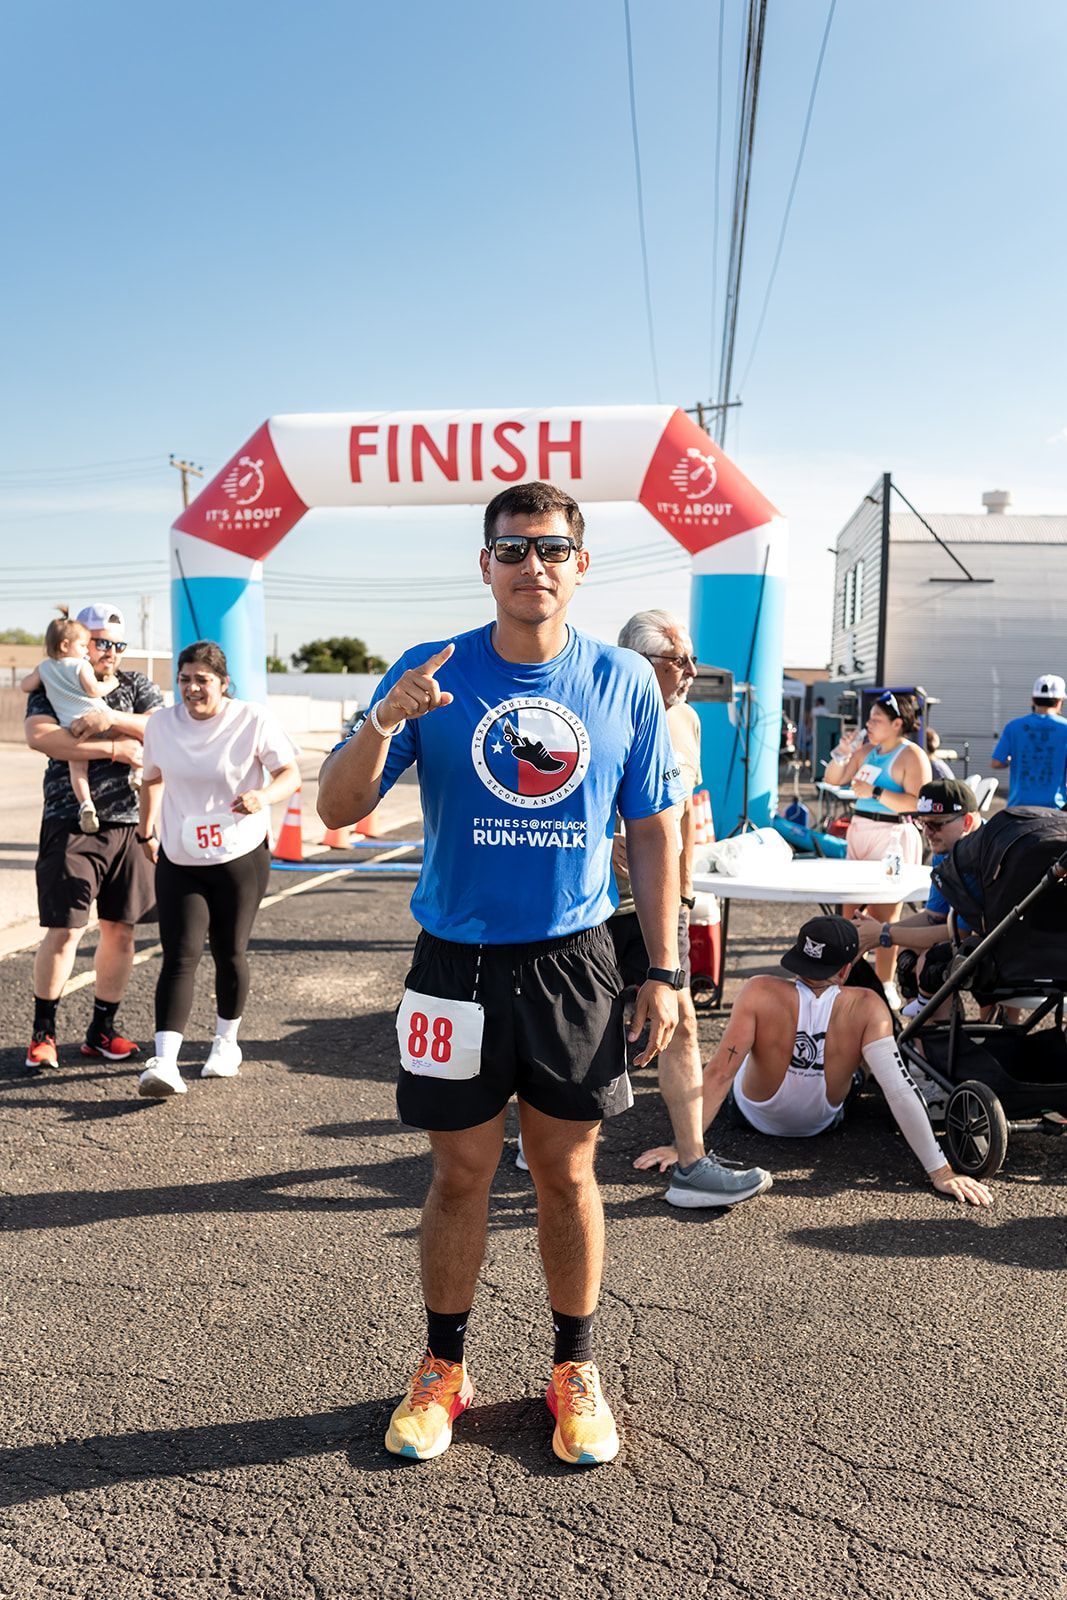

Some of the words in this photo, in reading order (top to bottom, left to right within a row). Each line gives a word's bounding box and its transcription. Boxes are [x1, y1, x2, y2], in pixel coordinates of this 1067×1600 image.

[349, 420, 583, 483] FINISH
[205, 509, 230, 522] IT'S
[234, 506, 282, 521] ABOUT
[657, 501, 680, 515] IT'S
[683, 502, 734, 516] ABOUT
[474, 716, 492, 749] TEXAS
[495, 699, 530, 716] ROUTE
[537, 699, 549, 707] 66
[556, 705, 588, 753] FESTIVAL
[487, 779, 526, 805] SECOND
[532, 782, 575, 806] ANNUAL
[196, 823, 223, 849] 55
[473, 828, 587, 848] RUN+WALK
[408, 1012, 453, 1063] 88
